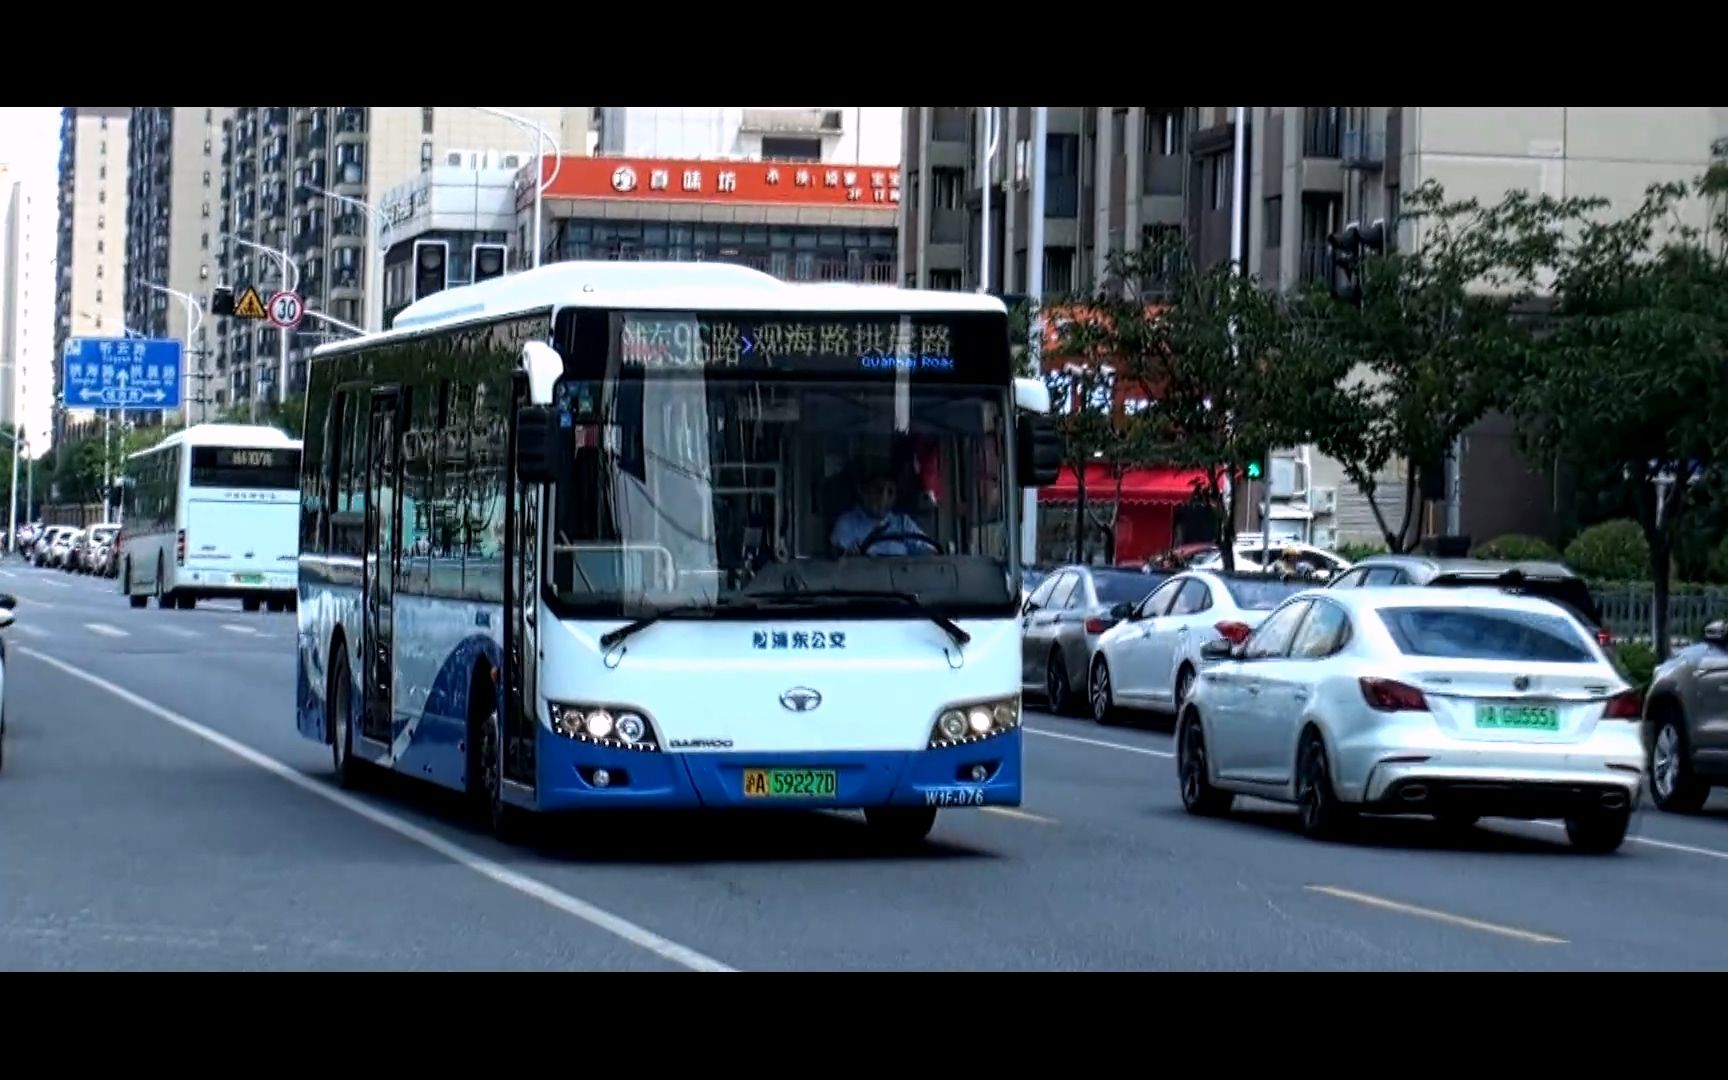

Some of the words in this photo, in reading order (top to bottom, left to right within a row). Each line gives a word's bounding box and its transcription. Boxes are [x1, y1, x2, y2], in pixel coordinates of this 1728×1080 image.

[278, 299, 295, 318] 30
[771, 629, 846, 649] 浦东公交
[774, 773, 834, 793] 59227D
